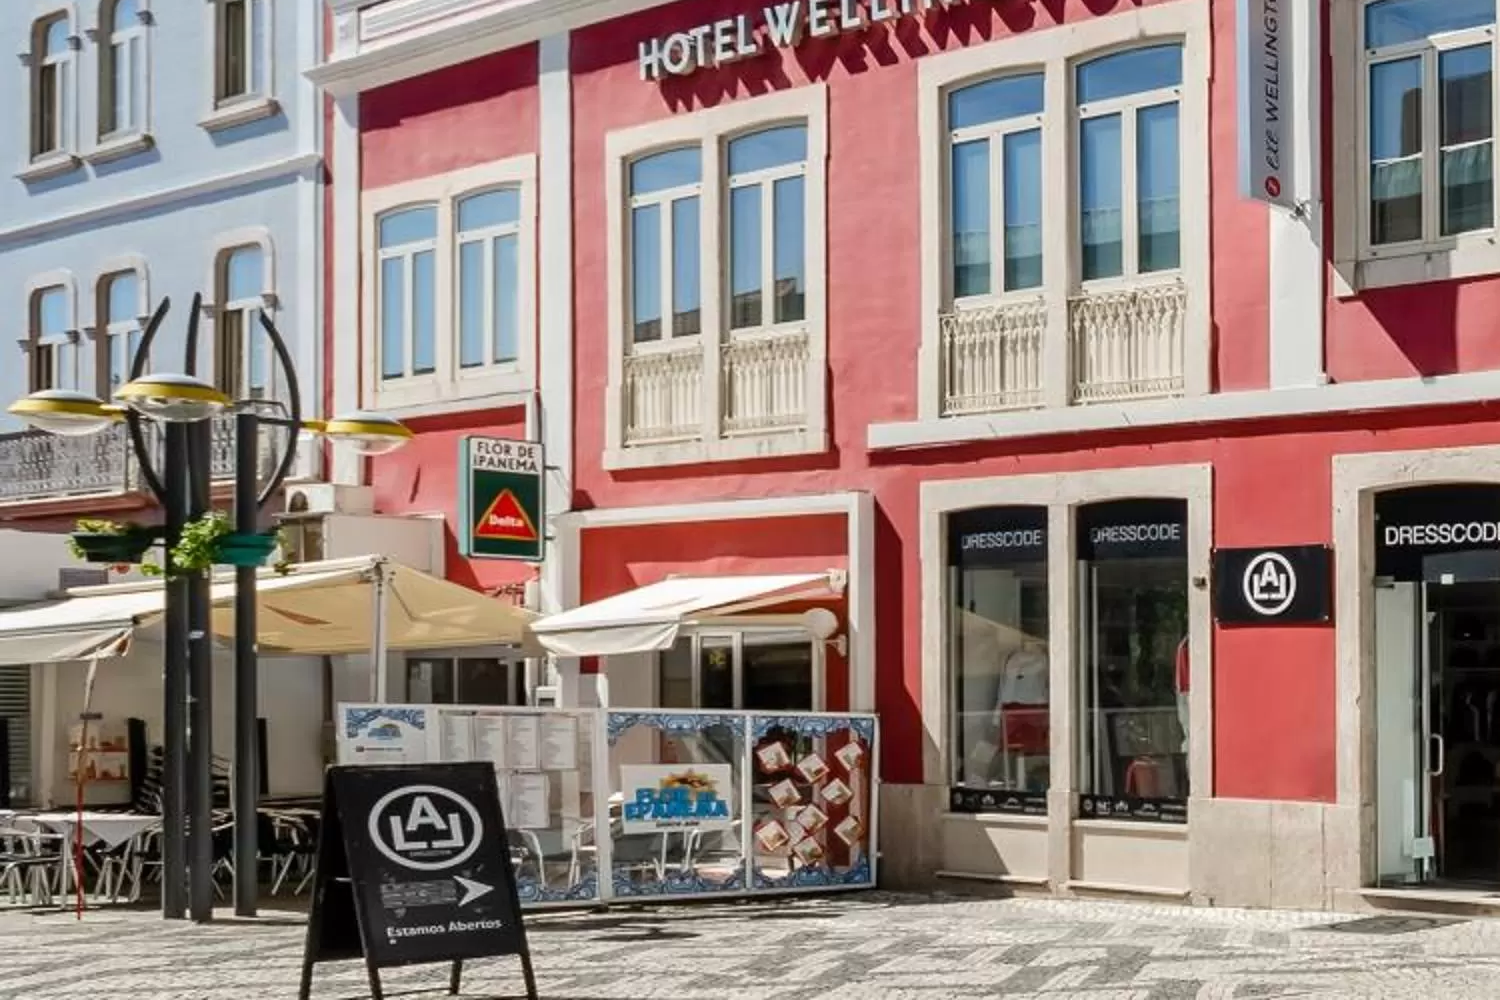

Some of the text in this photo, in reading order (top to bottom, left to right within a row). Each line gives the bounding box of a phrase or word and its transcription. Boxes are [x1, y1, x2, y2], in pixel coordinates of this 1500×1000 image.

[638, 14, 758, 81] HOTEL
[477, 441, 534, 458] FLOR DE
[474, 454, 539, 473] IPANEMA
[961, 529, 1042, 549] DRESSCODE
[1091, 523, 1181, 544] DRESSCODE
[386, 918, 503, 938] Estamos Abertos
